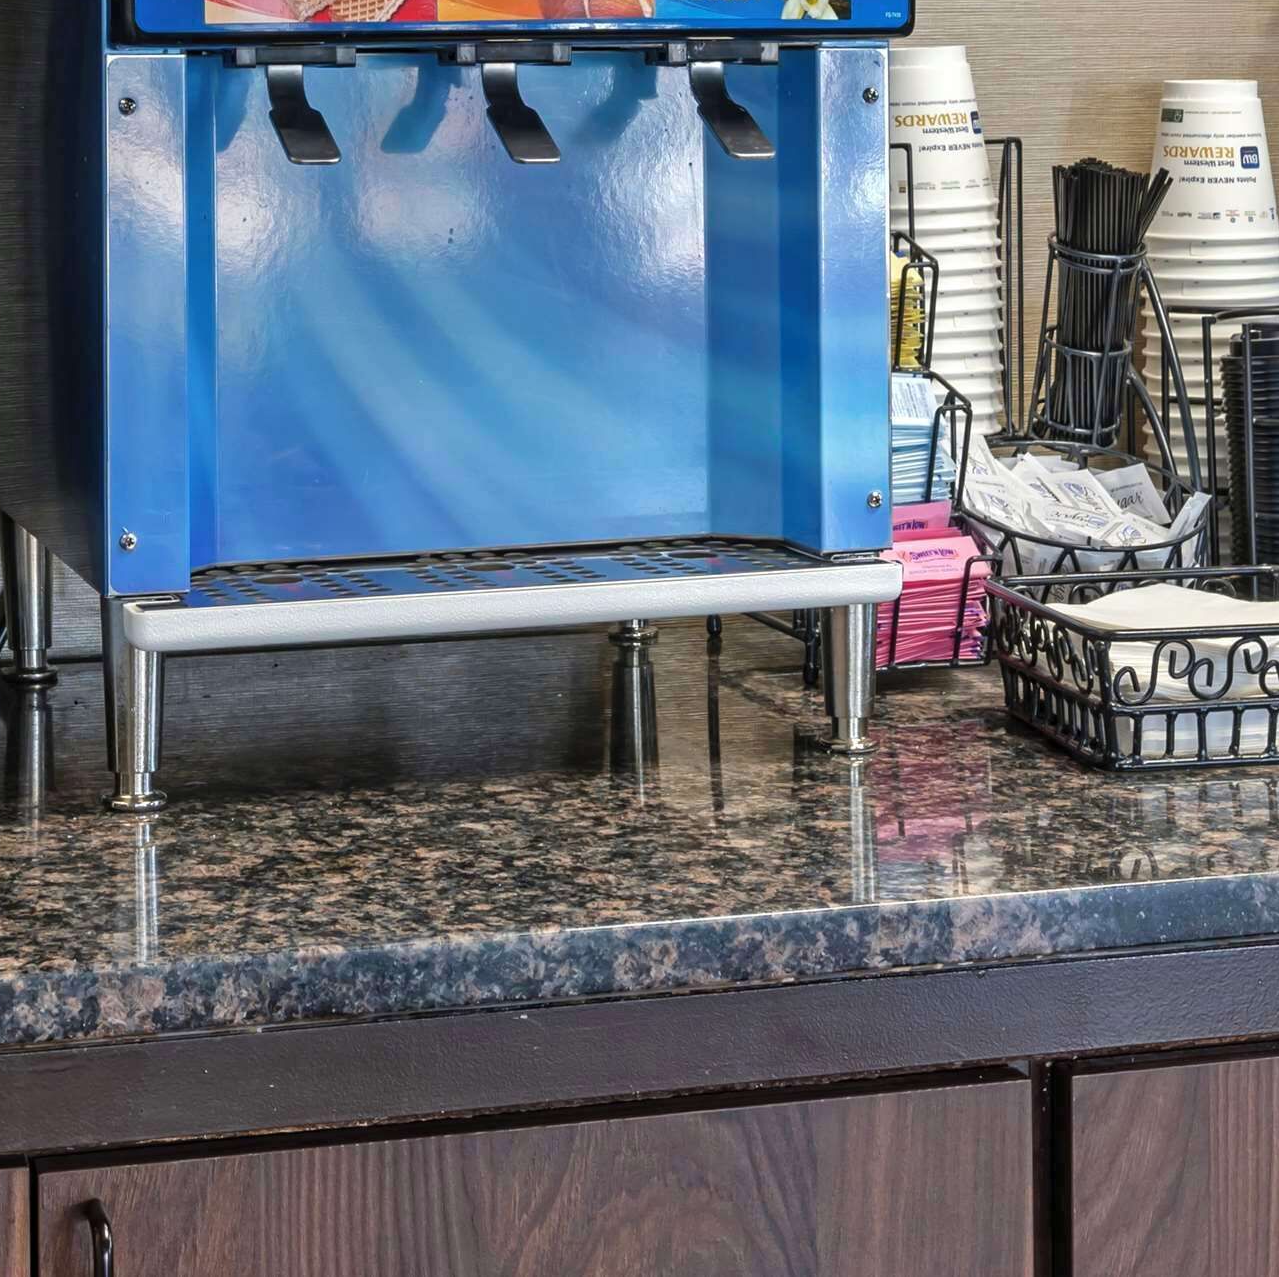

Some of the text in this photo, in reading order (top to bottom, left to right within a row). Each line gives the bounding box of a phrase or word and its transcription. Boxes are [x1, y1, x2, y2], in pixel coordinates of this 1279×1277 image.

[894, 112, 968, 128] REWARDS
[955, 126, 969, 134] Best
[1163, 145, 1235, 159] REWARDS
[1207, 176, 1235, 184] NEVER
[1237, 176, 1257, 184] Points
